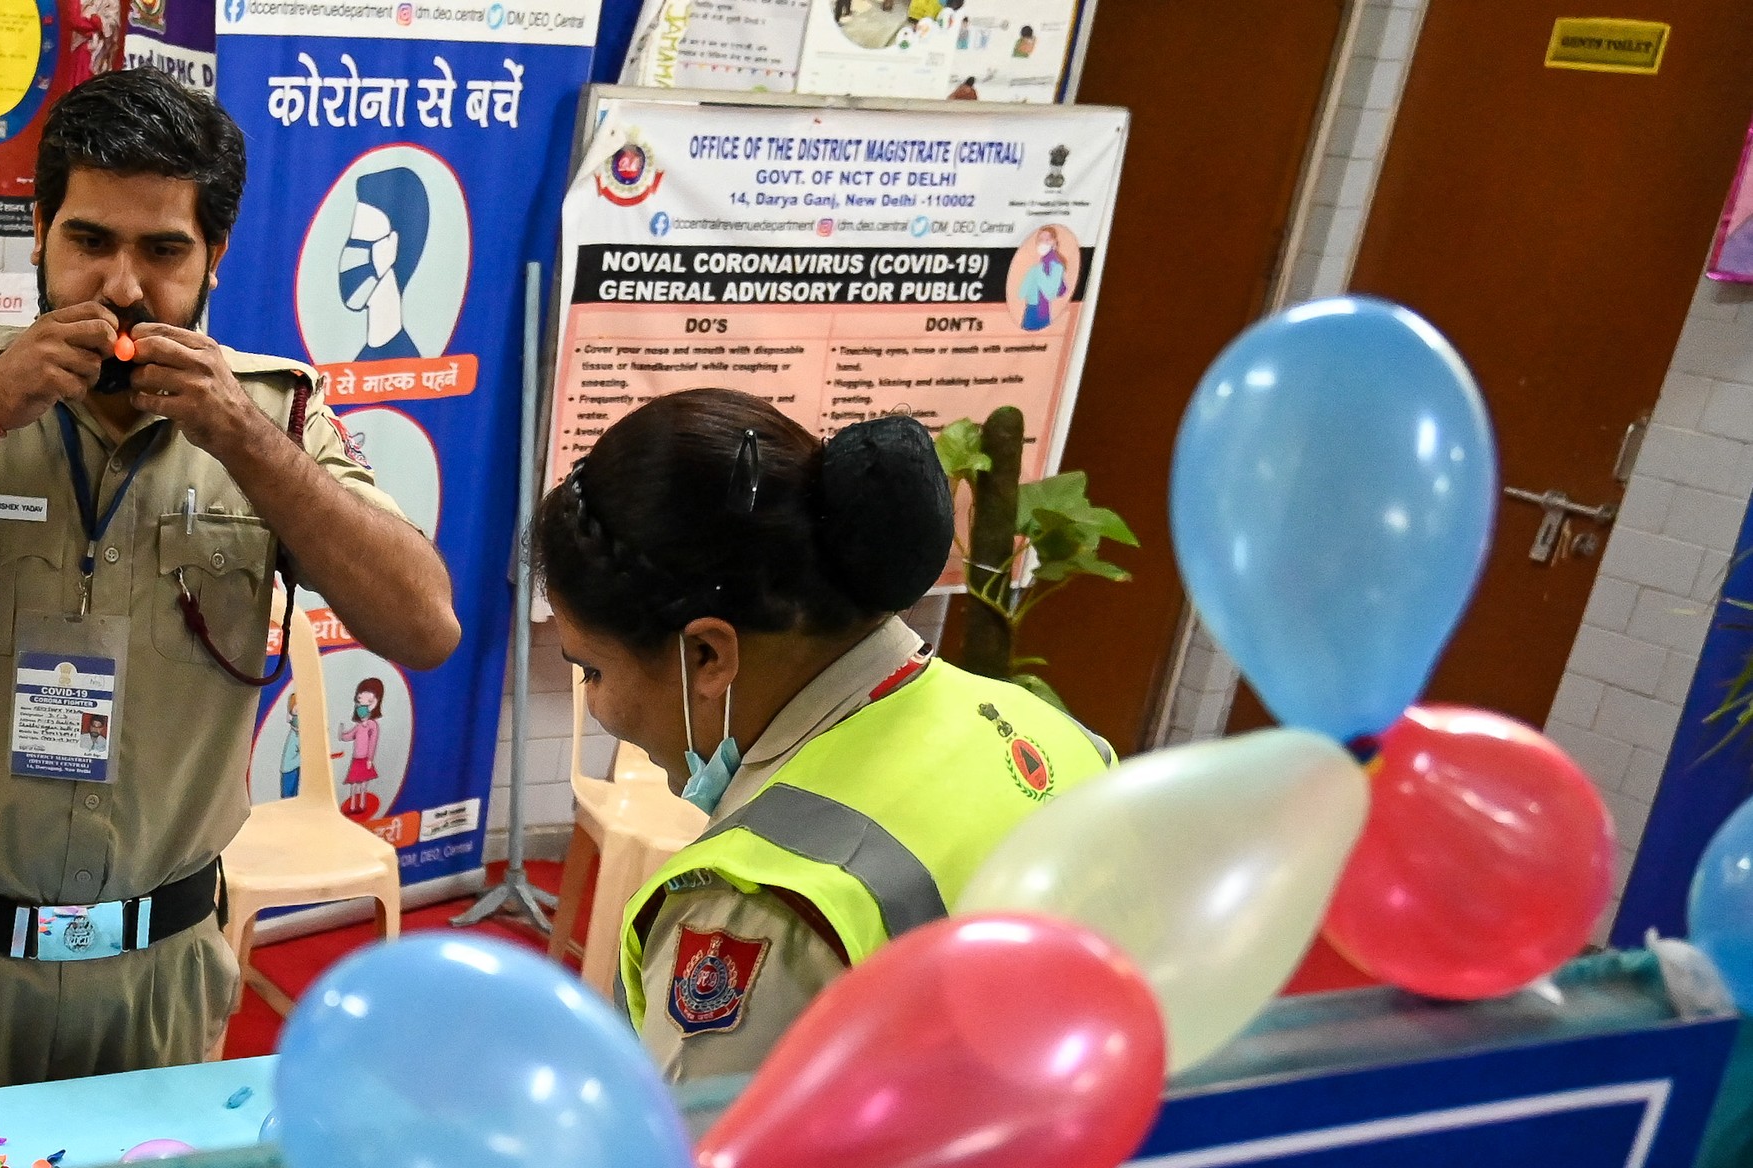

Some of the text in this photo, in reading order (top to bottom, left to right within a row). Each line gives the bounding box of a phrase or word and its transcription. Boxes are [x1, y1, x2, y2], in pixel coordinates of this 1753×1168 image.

[267, 51, 525, 129] कोरोना से बचें
[689, 135, 1025, 169] OFFICE OF THE DISTRICT MAGISTRATE (CENTRAL)
[755, 169, 957, 187] GOVT. OF NCT OF DELHI
[729, 192, 976, 210] 14, Darya Ganj, New Delhi -110002
[601, 251, 990, 279] NOVAL CORONAVIRUS (COVID-19)
[598, 280, 984, 303] GENERAL ADVISORY FOR PUBLIC
[684, 317, 729, 334] DO'S
[336, 368, 356, 396] से
[362, 372, 417, 393] मास्क
[21, 504, 44, 513] YADAV
[40, 686, 89, 698] COVID-19
[33, 696, 94, 708] CORONA FIGHTER
